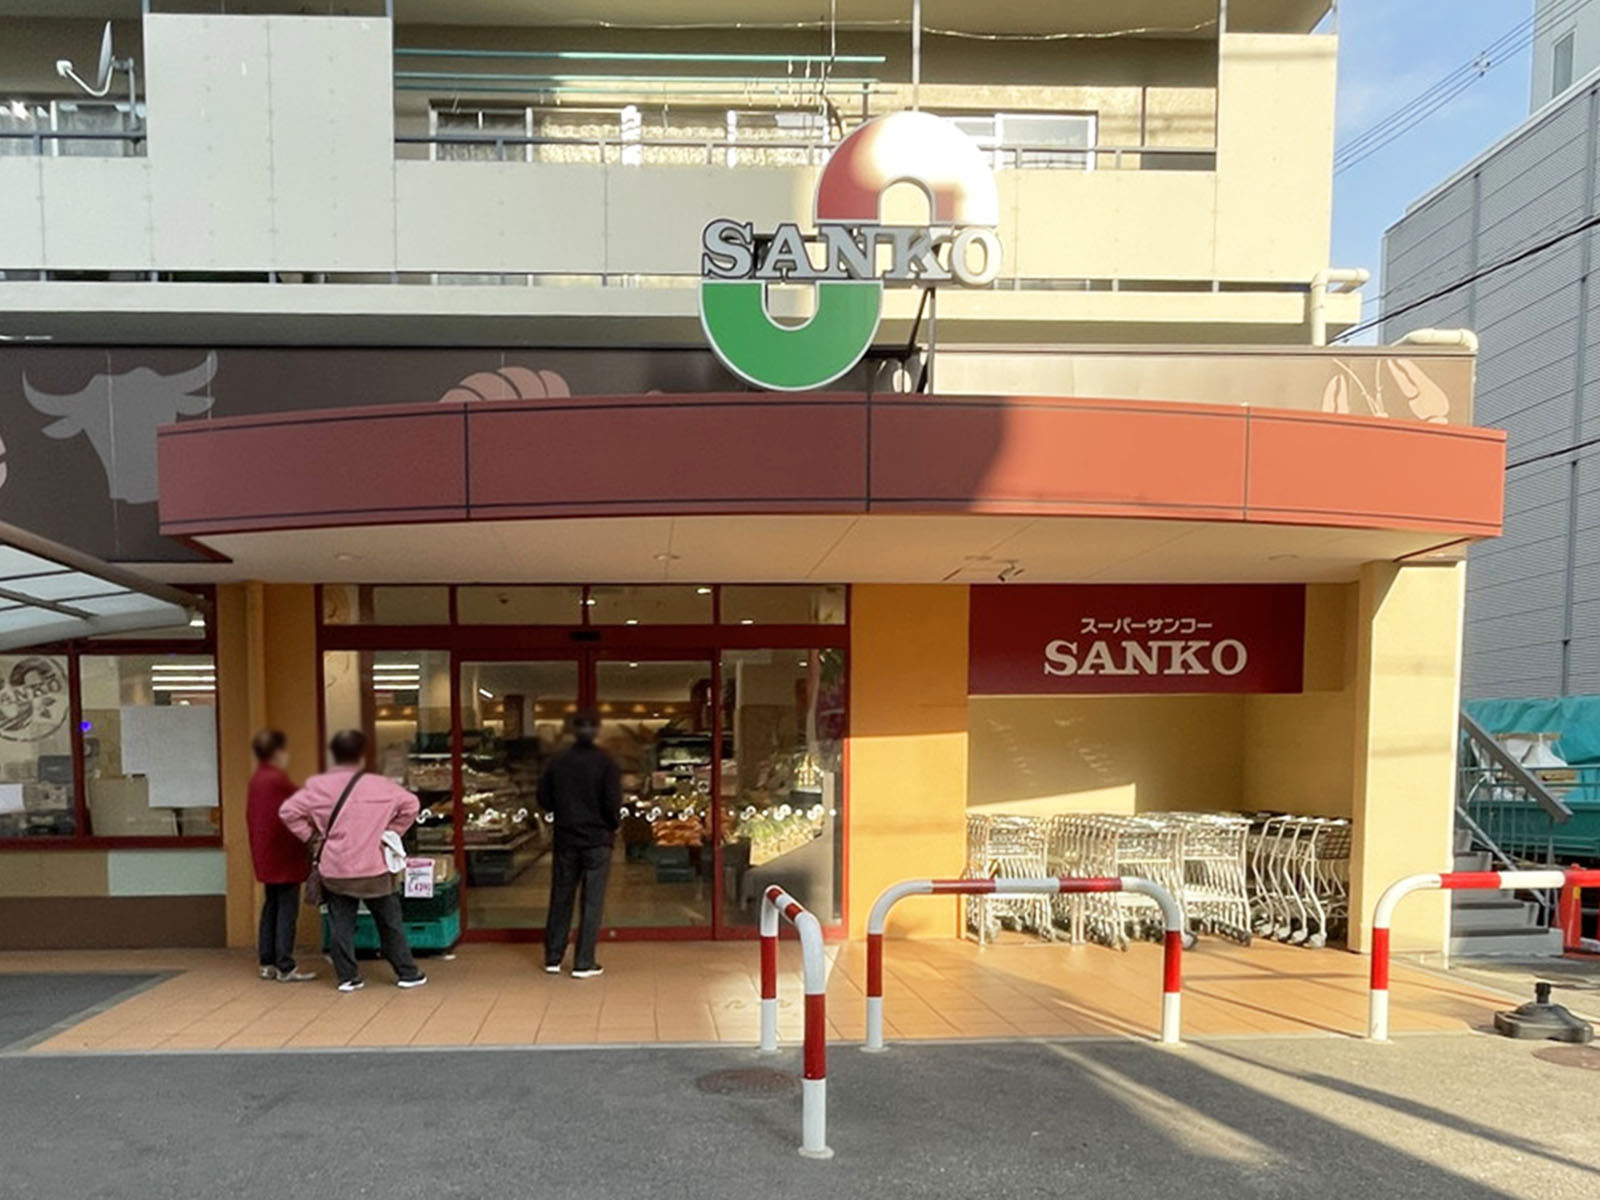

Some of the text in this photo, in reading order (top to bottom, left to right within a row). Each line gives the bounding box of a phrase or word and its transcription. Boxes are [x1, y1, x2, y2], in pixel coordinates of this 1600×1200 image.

[702, 219, 1001, 285] SANKO
[1080, 617, 1213, 634] スーパーサンコー
[1044, 639, 1248, 676] SANKO
[0, 677, 62, 705] ANKO
